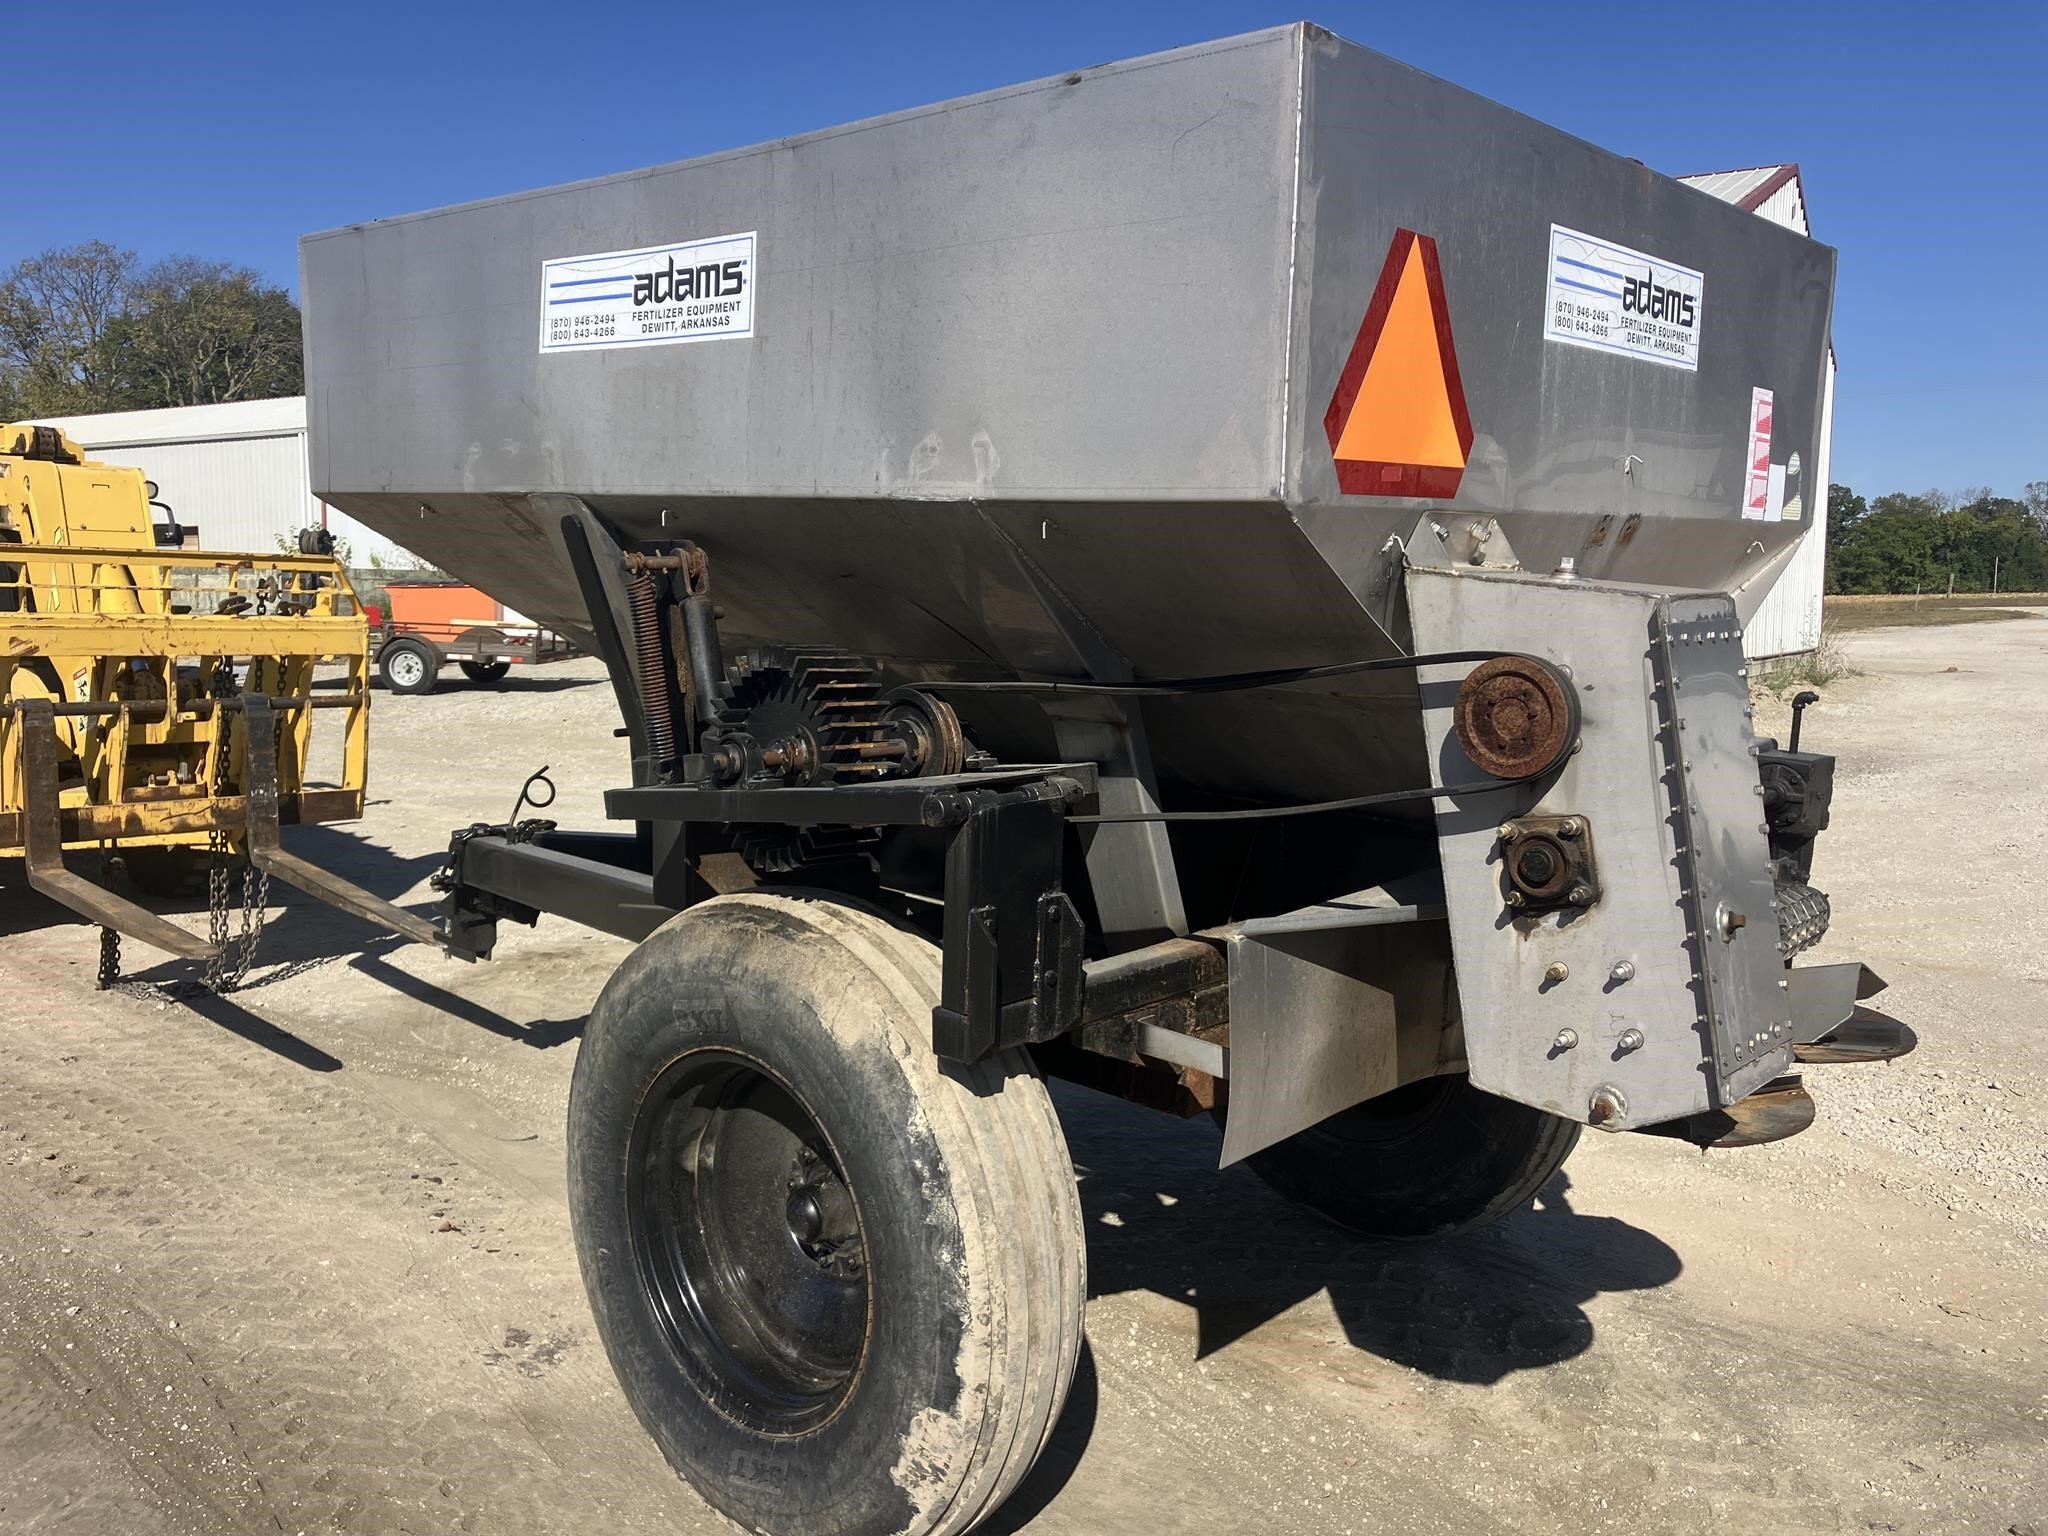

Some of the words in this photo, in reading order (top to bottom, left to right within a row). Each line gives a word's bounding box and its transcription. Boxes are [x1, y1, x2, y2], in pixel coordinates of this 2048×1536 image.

[633, 254, 743, 306] adams
[1622, 266, 1695, 328] adams
[551, 317, 571, 329] (870)
[574, 314, 615, 326] 946-2494
[632, 307, 683, 321] FERTILIZER
[687, 301, 741, 316] EQUIPMENT
[1555, 300, 1575, 316] (870)
[1576, 305, 1609, 323] 946-2494
[551, 330, 571, 342] (800)
[574, 326, 615, 338] 643-4266
[641, 321, 678, 334] DEWITT,
[681, 316, 730, 331] ARKANSAS
[1554, 314, 1574, 331] (800)
[1575, 320, 1609, 337] 643-4266
[1620, 316, 1657, 334] FERTILIZER
[1658, 326, 1692, 343] EQUIPMENT
[1627, 332, 1652, 348] DEWITT,
[1654, 339, 1685, 356] ARKANSAS
